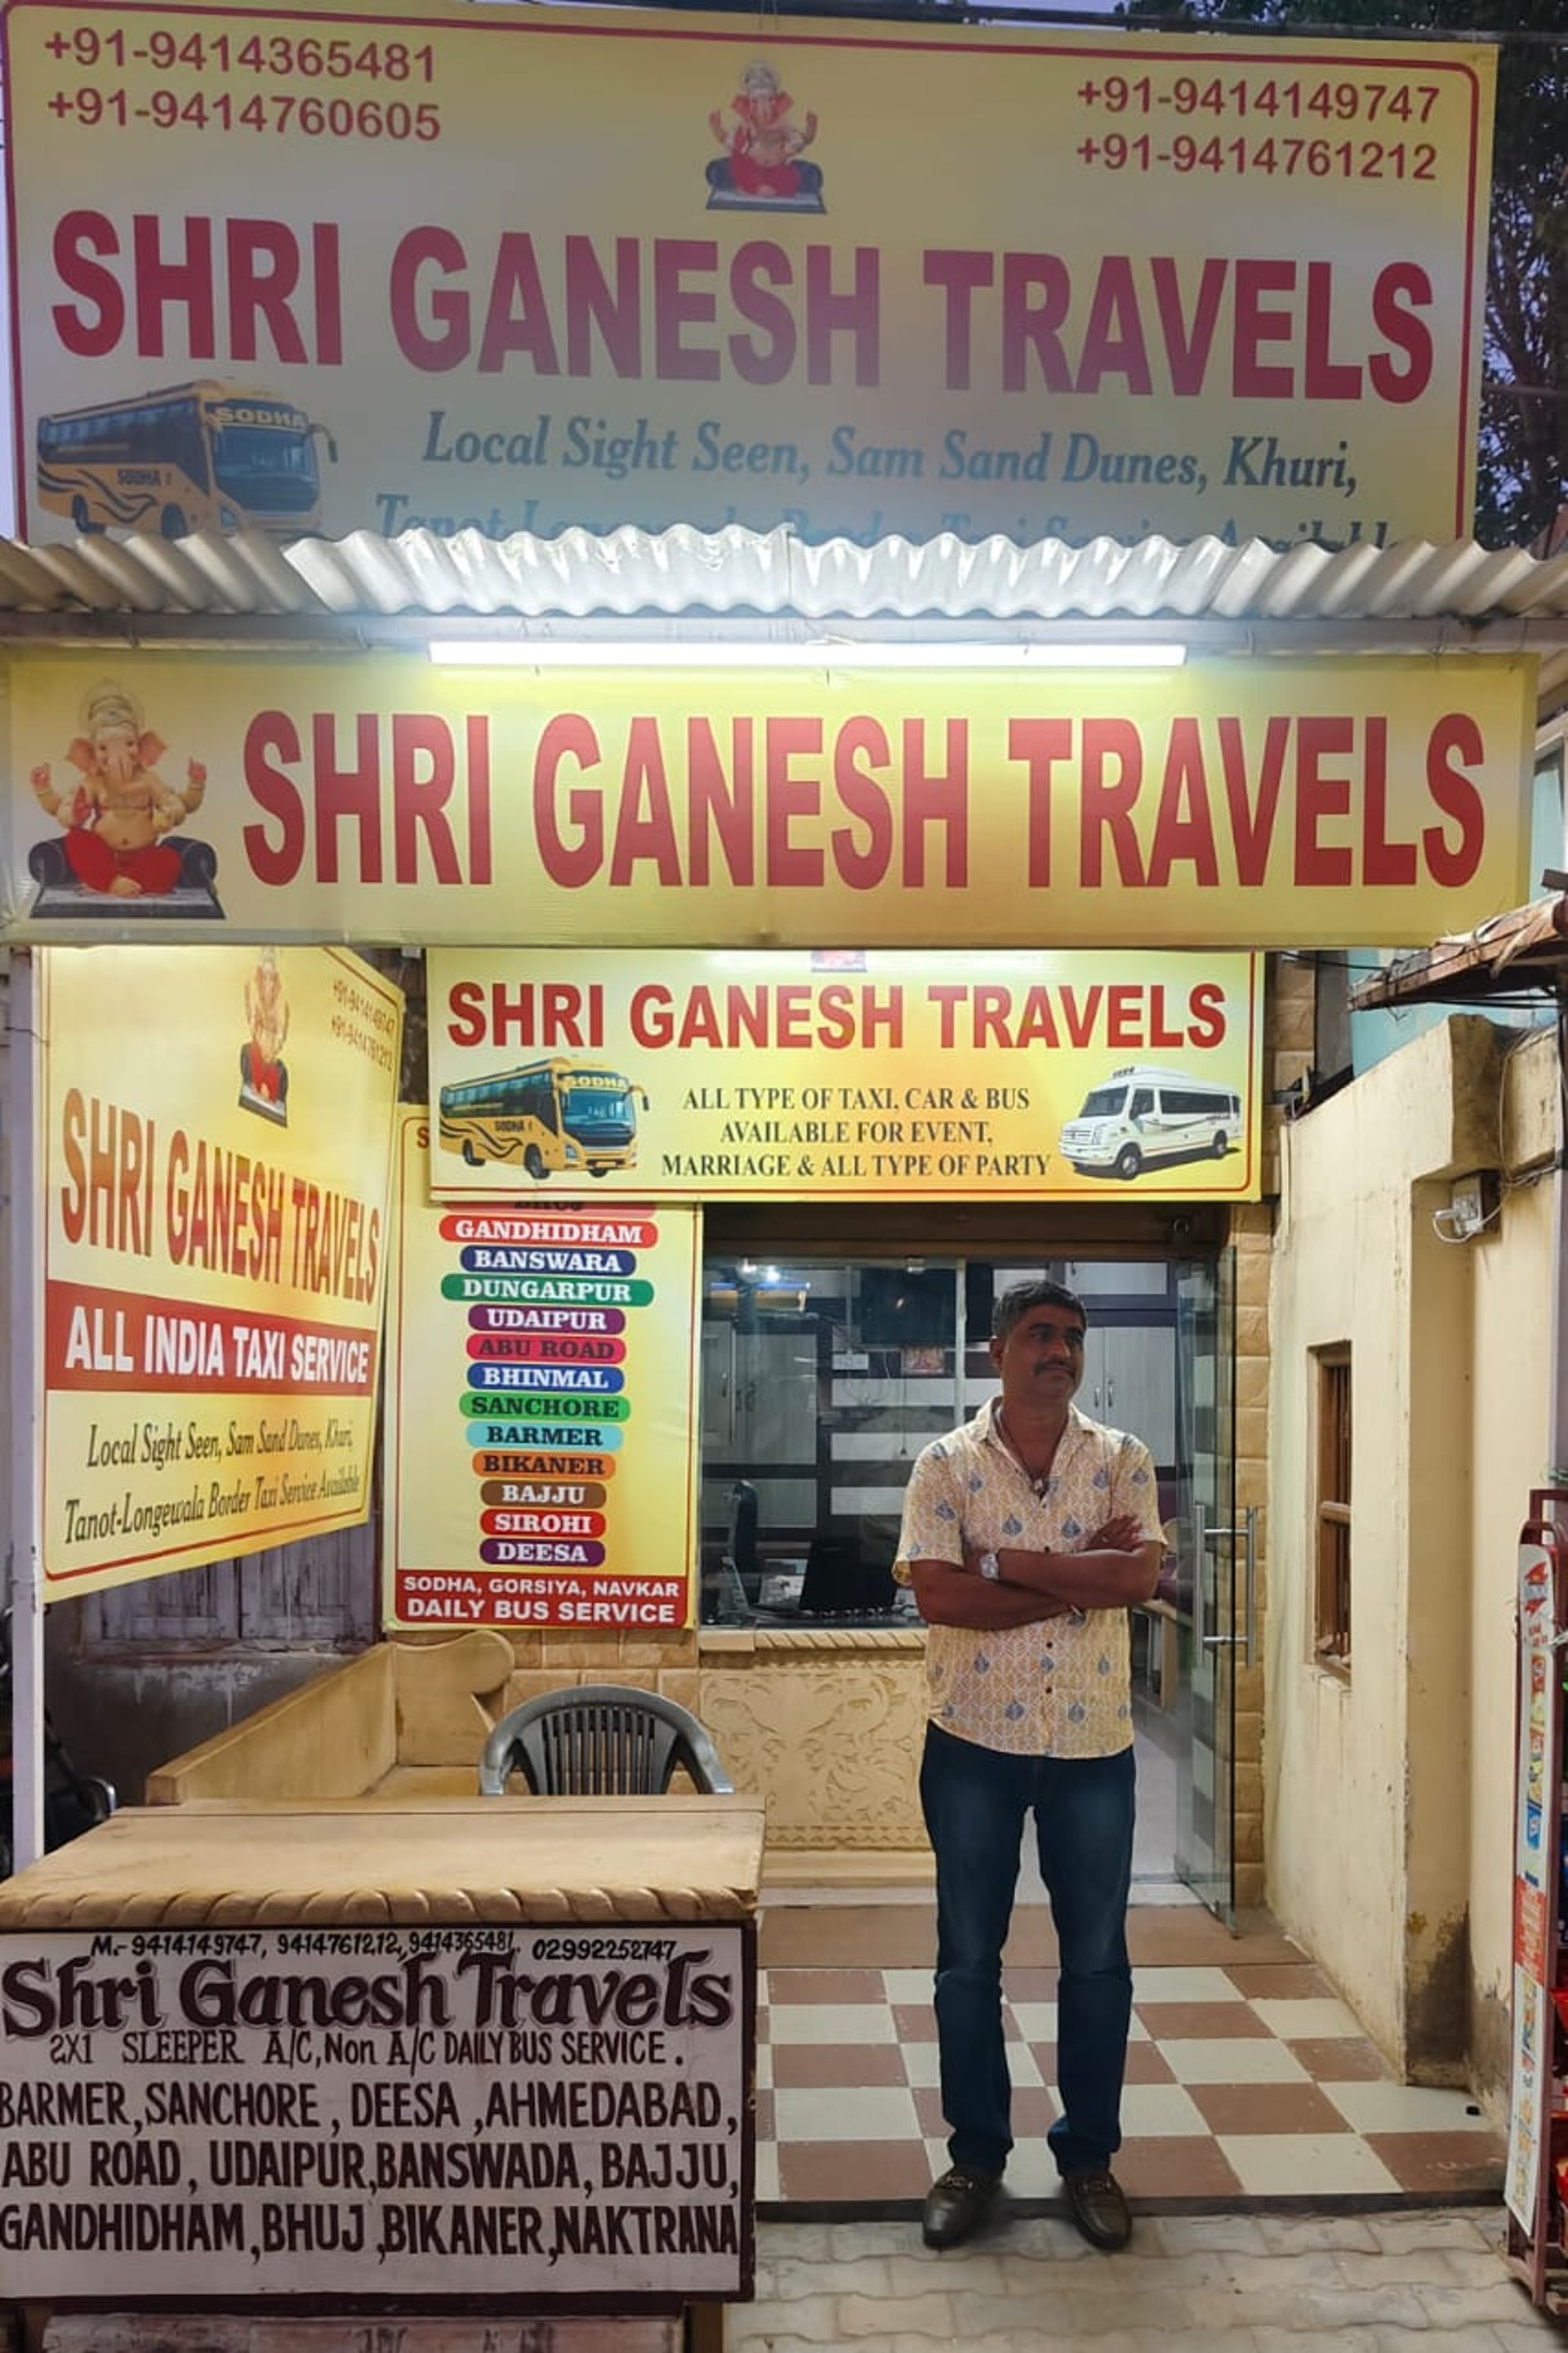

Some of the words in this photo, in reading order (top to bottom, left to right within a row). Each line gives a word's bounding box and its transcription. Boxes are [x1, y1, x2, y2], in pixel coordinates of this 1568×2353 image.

[44, 27, 436, 83] +91-9414365481
[1078, 76, 1440, 123] +91-9414149747
[47, 88, 441, 141] +91-9414760605
[1076, 133, 1437, 180] +91-9414761212
[51, 209, 343, 366] SHRI
[390, 225, 880, 389] GANESH
[924, 248, 1433, 403] TRAVELS
[216, 408, 309, 429] SODHA
[422, 410, 548, 465] Local
[564, 417, 678, 480] Sight
[692, 421, 810, 484] Seen,
[826, 426, 924, 480] Sam
[938, 429, 1053, 484] Sand
[1062, 433, 1207, 494] Dunes,
[1224, 436, 1357, 496] Khuri,
[243, 709, 492, 887] SHRI
[532, 713, 968, 889] GANESH
[1007, 712, 1484, 889] TRAVELS
[447, 981, 604, 1049] SHRI
[629, 984, 903, 1049] GANESH
[928, 983, 1227, 1049] TRAVELS
[684, 1087, 729, 1110] ALL
[738, 1087, 795, 1110] TYPE
[802, 1087, 833, 1110] OF
[906, 1087, 953, 1110] CAR
[961, 1088, 979, 1110] &
[986, 1088, 1030, 1110] BUS
[720, 1121, 849, 1143] AVAILABLE
[858, 1121, 903, 1143] FOR
[662, 1154, 789, 1177] MARRIAGE
[796, 1155, 815, 1177] &
[822, 1155, 866, 1177] ALL
[871, 1155, 933, 1177] TYPE
[938, 1155, 969, 1177] OF
[978, 1155, 1052, 1177] PARTY
[61, 1087, 155, 1258] SHRI
[167, 1130, 285, 1285] GANESH
[292, 1177, 380, 1305] TRAVELS
[456, 1220, 642, 1244] GANDHIDHAM
[474, 1250, 621, 1272] BANSWARA
[463, 1279, 631, 1302] DUNGARPUR
[487, 1308, 607, 1330] UDAIPUR
[65, 1305, 133, 1373] ALL
[145, 1314, 225, 1377] INDIA
[233, 1326, 286, 1380] TAXI
[291, 1333, 368, 1384] SERVICE
[478, 1339, 532, 1356] ABU
[540, 1340, 615, 1358] ROAD
[483, 1367, 608, 1388] BHINMAL
[471, 1397, 619, 1418] SANCHORE
[87, 1423, 137, 1468] Local
[141, 1422, 184, 1471] Sight
[185, 1421, 222, 1465] Seen,
[225, 1421, 254, 1457] Sam
[257, 1419, 287, 1454] Sand
[487, 1426, 603, 1446] BARMER
[483, 1455, 605, 1475] BIKANER
[502, 1485, 586, 1504] BAJJU
[65, 1484, 204, 1544] Tanot-Longewala
[207, 1482, 250, 1519] Border
[255, 1475, 279, 1511] Taxi
[495, 1515, 591, 1534] SIROHI
[497, 1543, 588, 1562] DEESA
[403, 1577, 483, 1593] SODHA,
[489, 1579, 586, 1596] GORSIYA,
[593, 1582, 679, 1597] NAVKAR
[408, 1599, 485, 1618] DAILY
[494, 1601, 548, 1619] BUS
[558, 1602, 675, 1622] SERVICE
[532, 1939, 677, 1960] 02992252747
[2, 1956, 163, 2039] Shri
[179, 1951, 455, 2029] Ganesh
[457, 1950, 733, 2028] Travels
[50, 2034, 93, 2066] 2X1
[122, 2030, 245, 2066] SLEEPER
[389, 2027, 434, 2077] A/C
[444, 2030, 502, 2066] DAILY
[510, 2030, 552, 2066] BUS
[2, 2141, 71, 2188] ABU
[601, 2141, 738, 2199] BAJJU,
[555, 2205, 739, 2254] NAKTRANA
